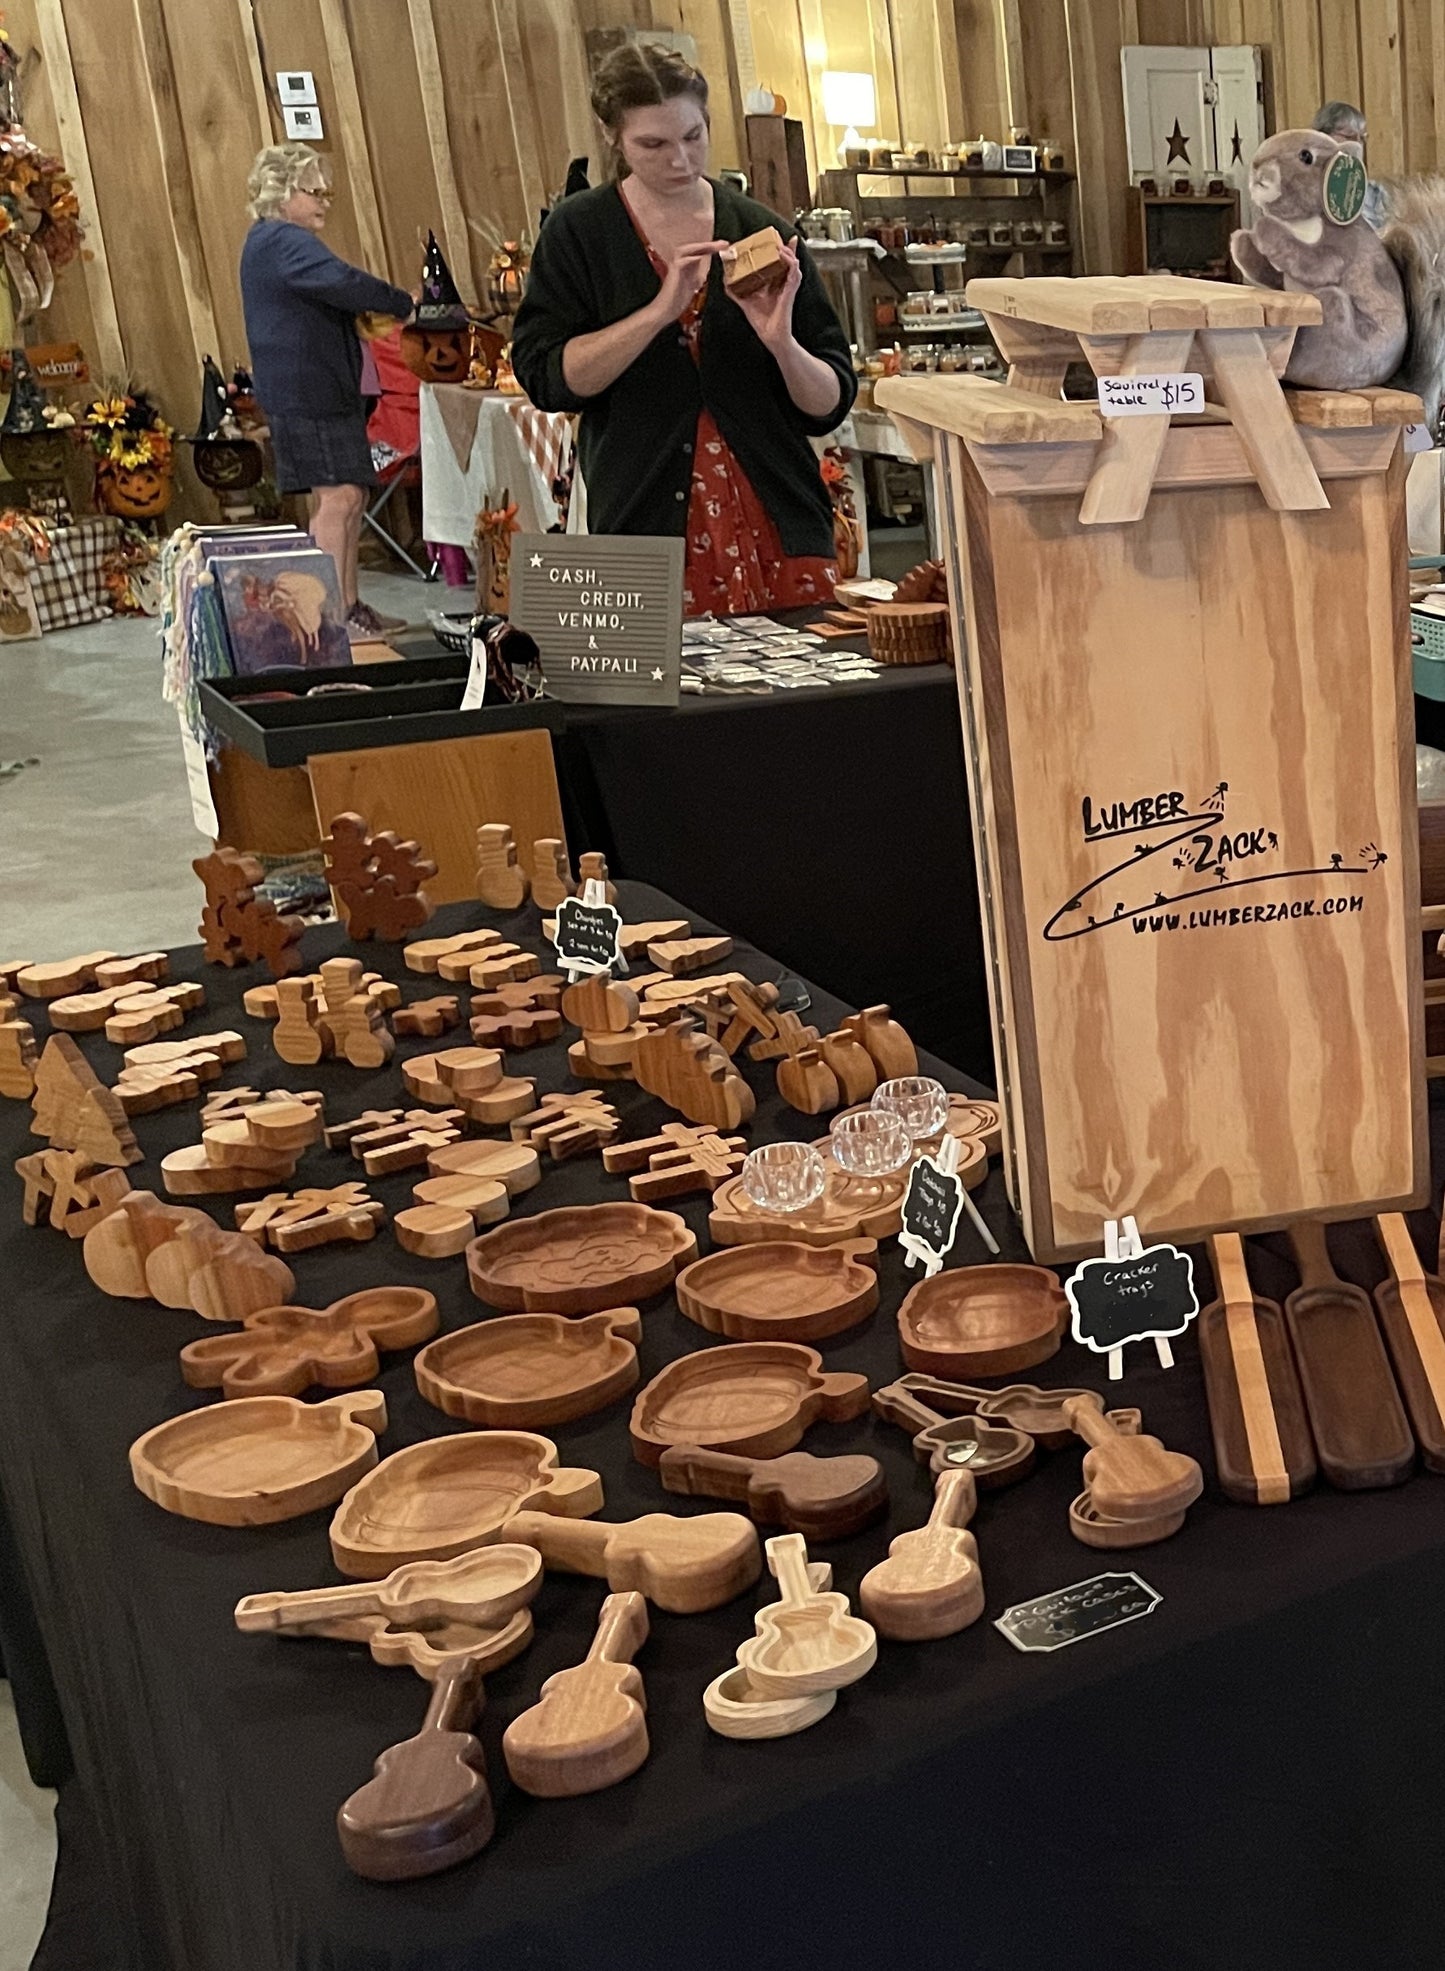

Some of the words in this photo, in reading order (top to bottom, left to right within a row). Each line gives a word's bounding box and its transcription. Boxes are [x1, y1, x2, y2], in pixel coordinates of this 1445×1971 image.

[1107, 395, 1147, 405] table
[1161, 381, 1195, 410] $15
[549, 567, 603, 587] CASH,
[580, 591, 645, 610] CREDIT,
[588, 635, 599, 650] &
[1192, 827, 1267, 873] ZACK
[1132, 896, 1364, 934] WWW.LUMBERZACK.COM
[1103, 1262, 1160, 1286] Cracker
[1117, 1279, 1154, 1298] trays
